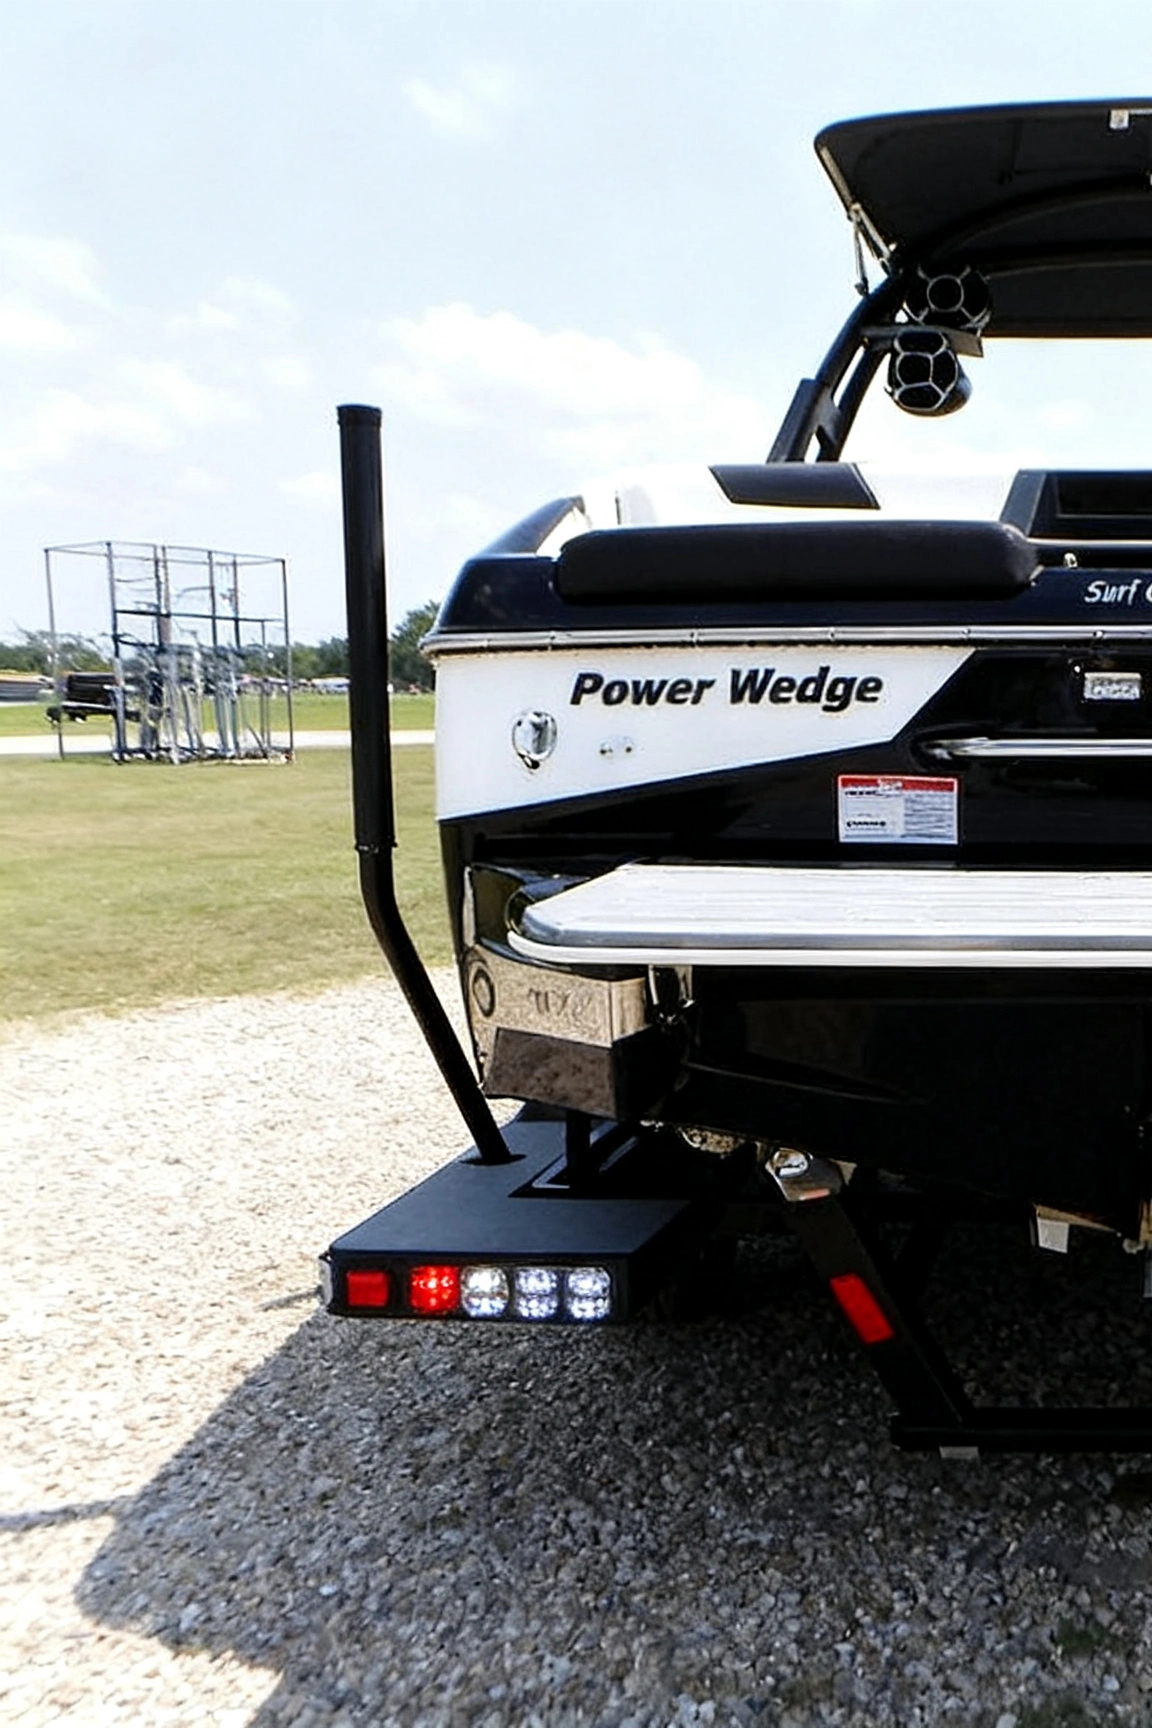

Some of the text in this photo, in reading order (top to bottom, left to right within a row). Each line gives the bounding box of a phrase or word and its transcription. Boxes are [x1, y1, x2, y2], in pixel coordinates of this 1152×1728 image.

[1084, 578, 1142, 606] Surf
[570, 665, 884, 713] Power Wedge
